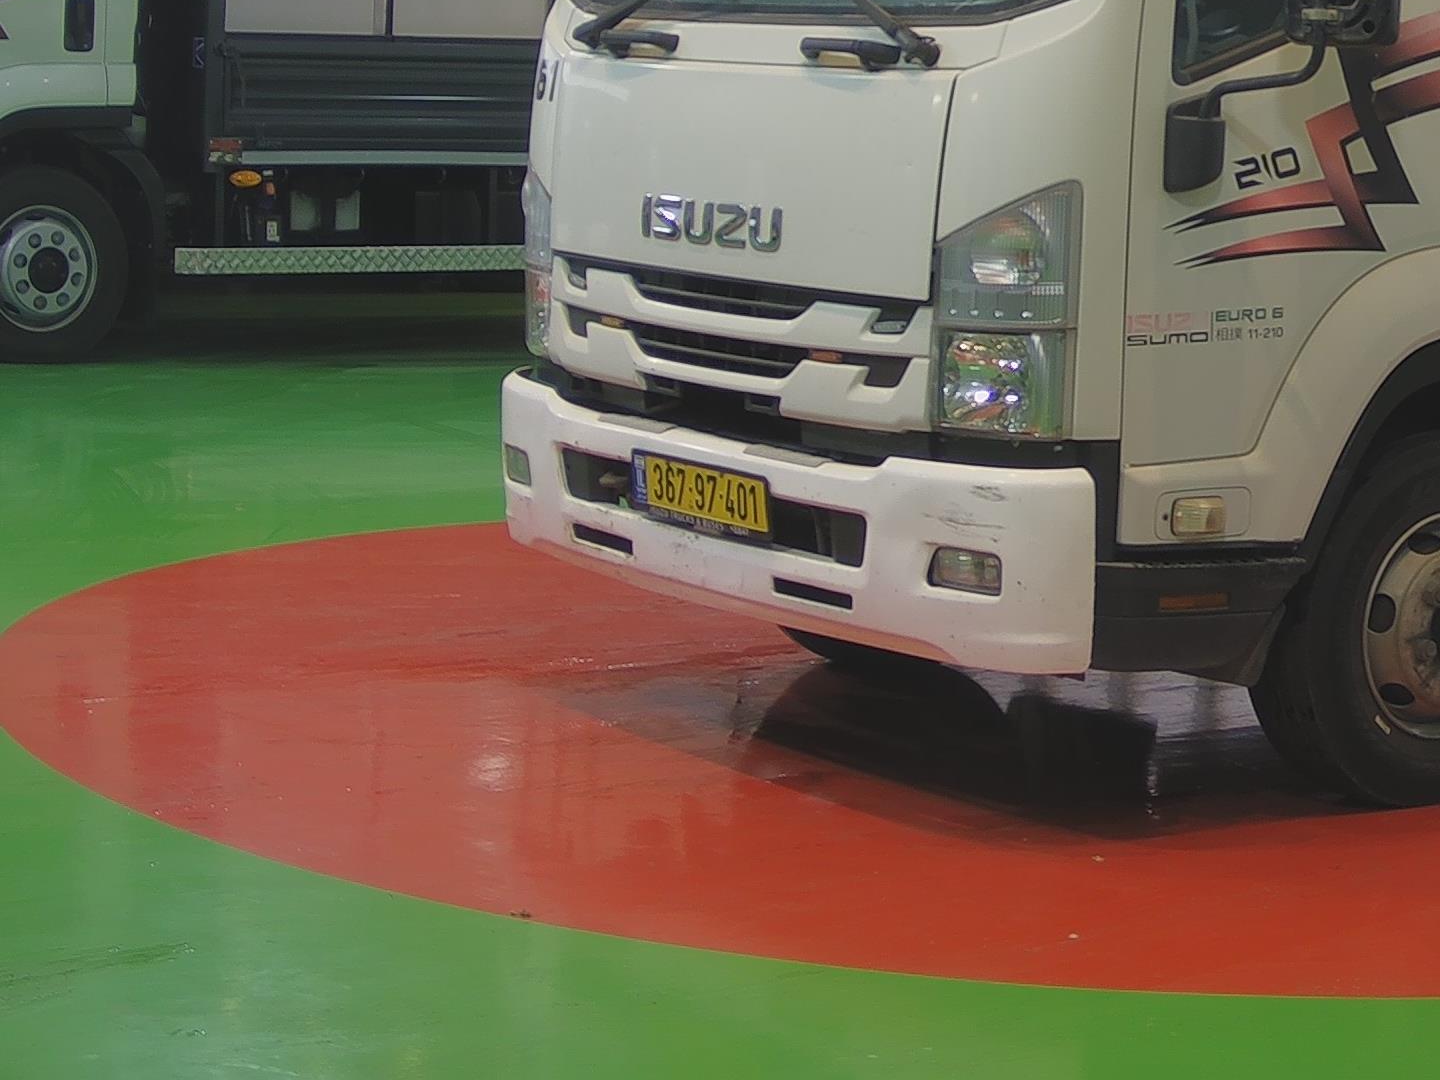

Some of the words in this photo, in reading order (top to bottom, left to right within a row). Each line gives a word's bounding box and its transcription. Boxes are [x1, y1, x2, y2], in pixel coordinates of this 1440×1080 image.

[1234, 146, 1301, 190] 210
[641, 191, 784, 253] ISUZU
[1215, 308, 1268, 322] EURO
[1272, 306, 1284, 319] 6
[1126, 331, 1209, 347] SUMO
